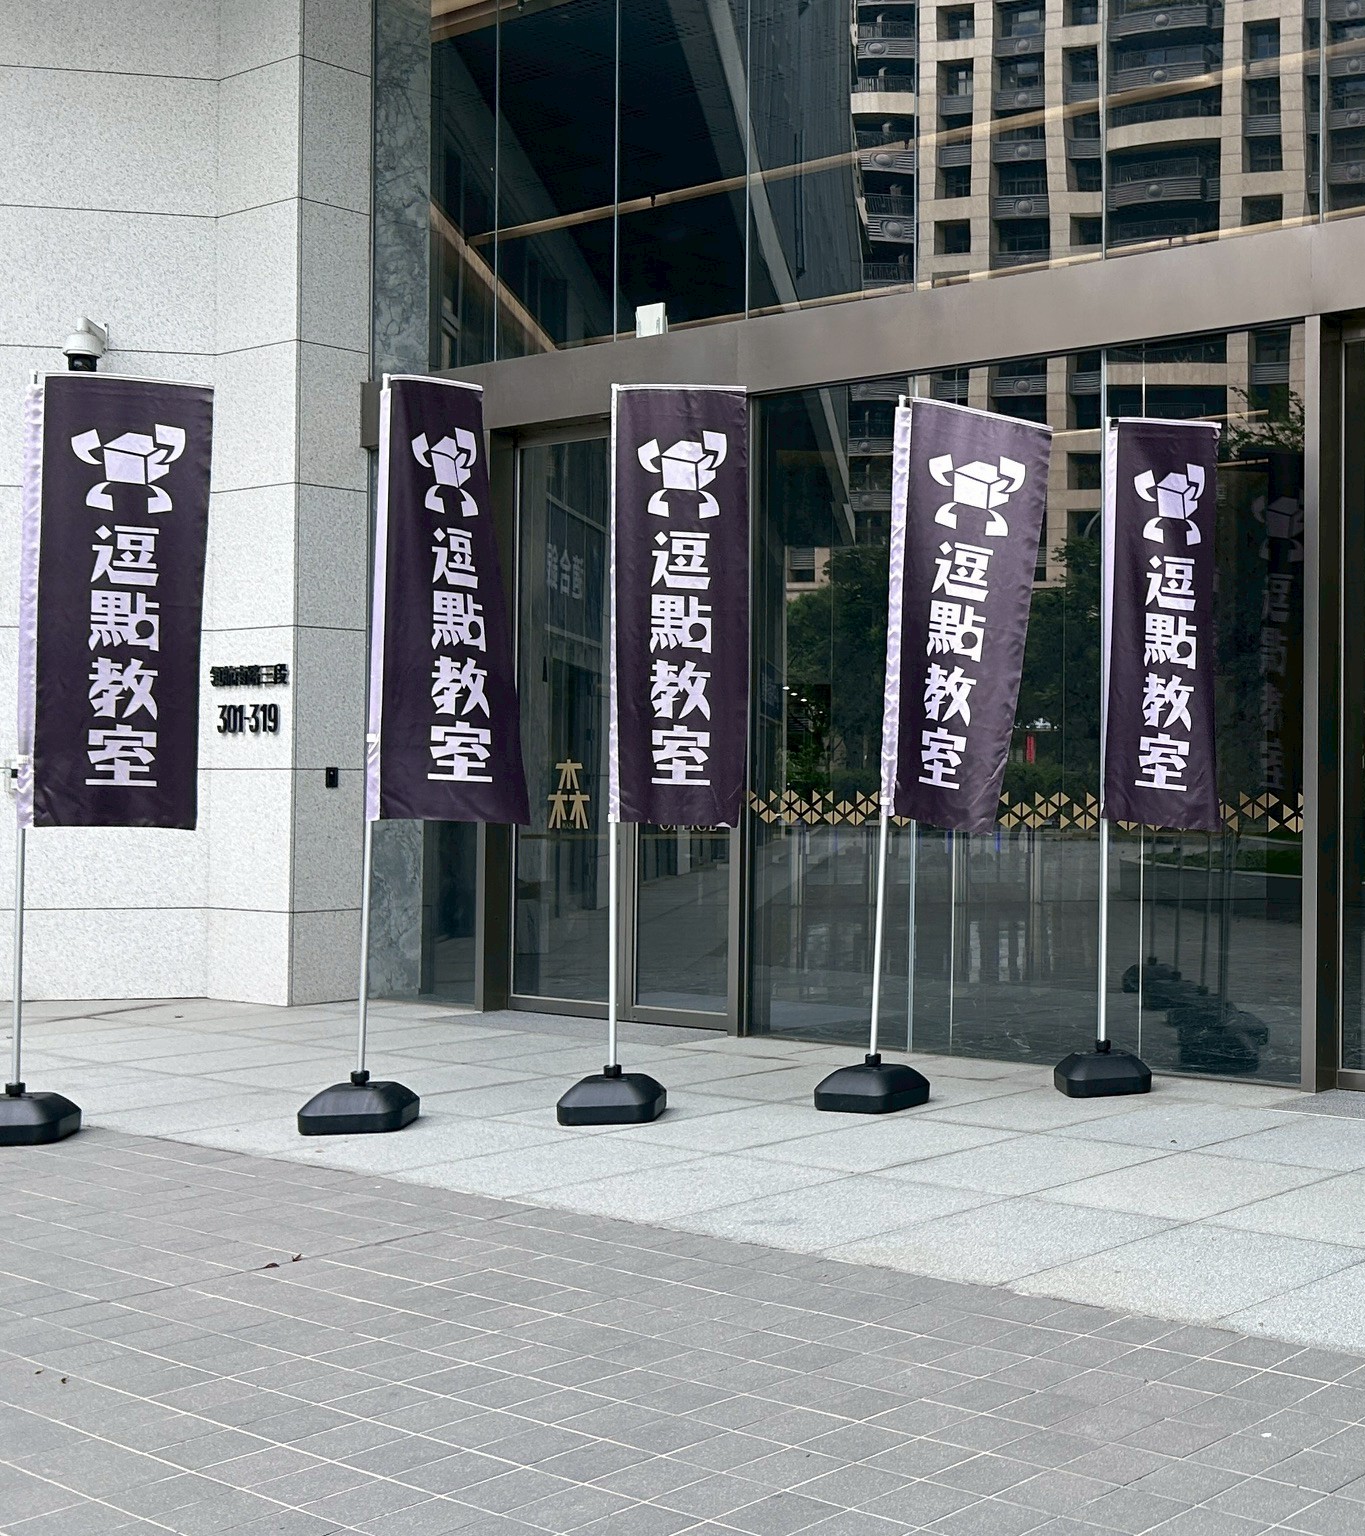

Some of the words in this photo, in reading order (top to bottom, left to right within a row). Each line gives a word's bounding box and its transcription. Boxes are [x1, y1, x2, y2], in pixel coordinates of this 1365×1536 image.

[85, 524, 160, 787] 逗點教室
[216, 703, 279, 733] 301-319
[427, 527, 493, 783] 逗點教室
[650, 530, 712, 786] 逗點教室
[918, 541, 994, 790] 逗點教室
[1134, 555, 1197, 792] 逗點教室
